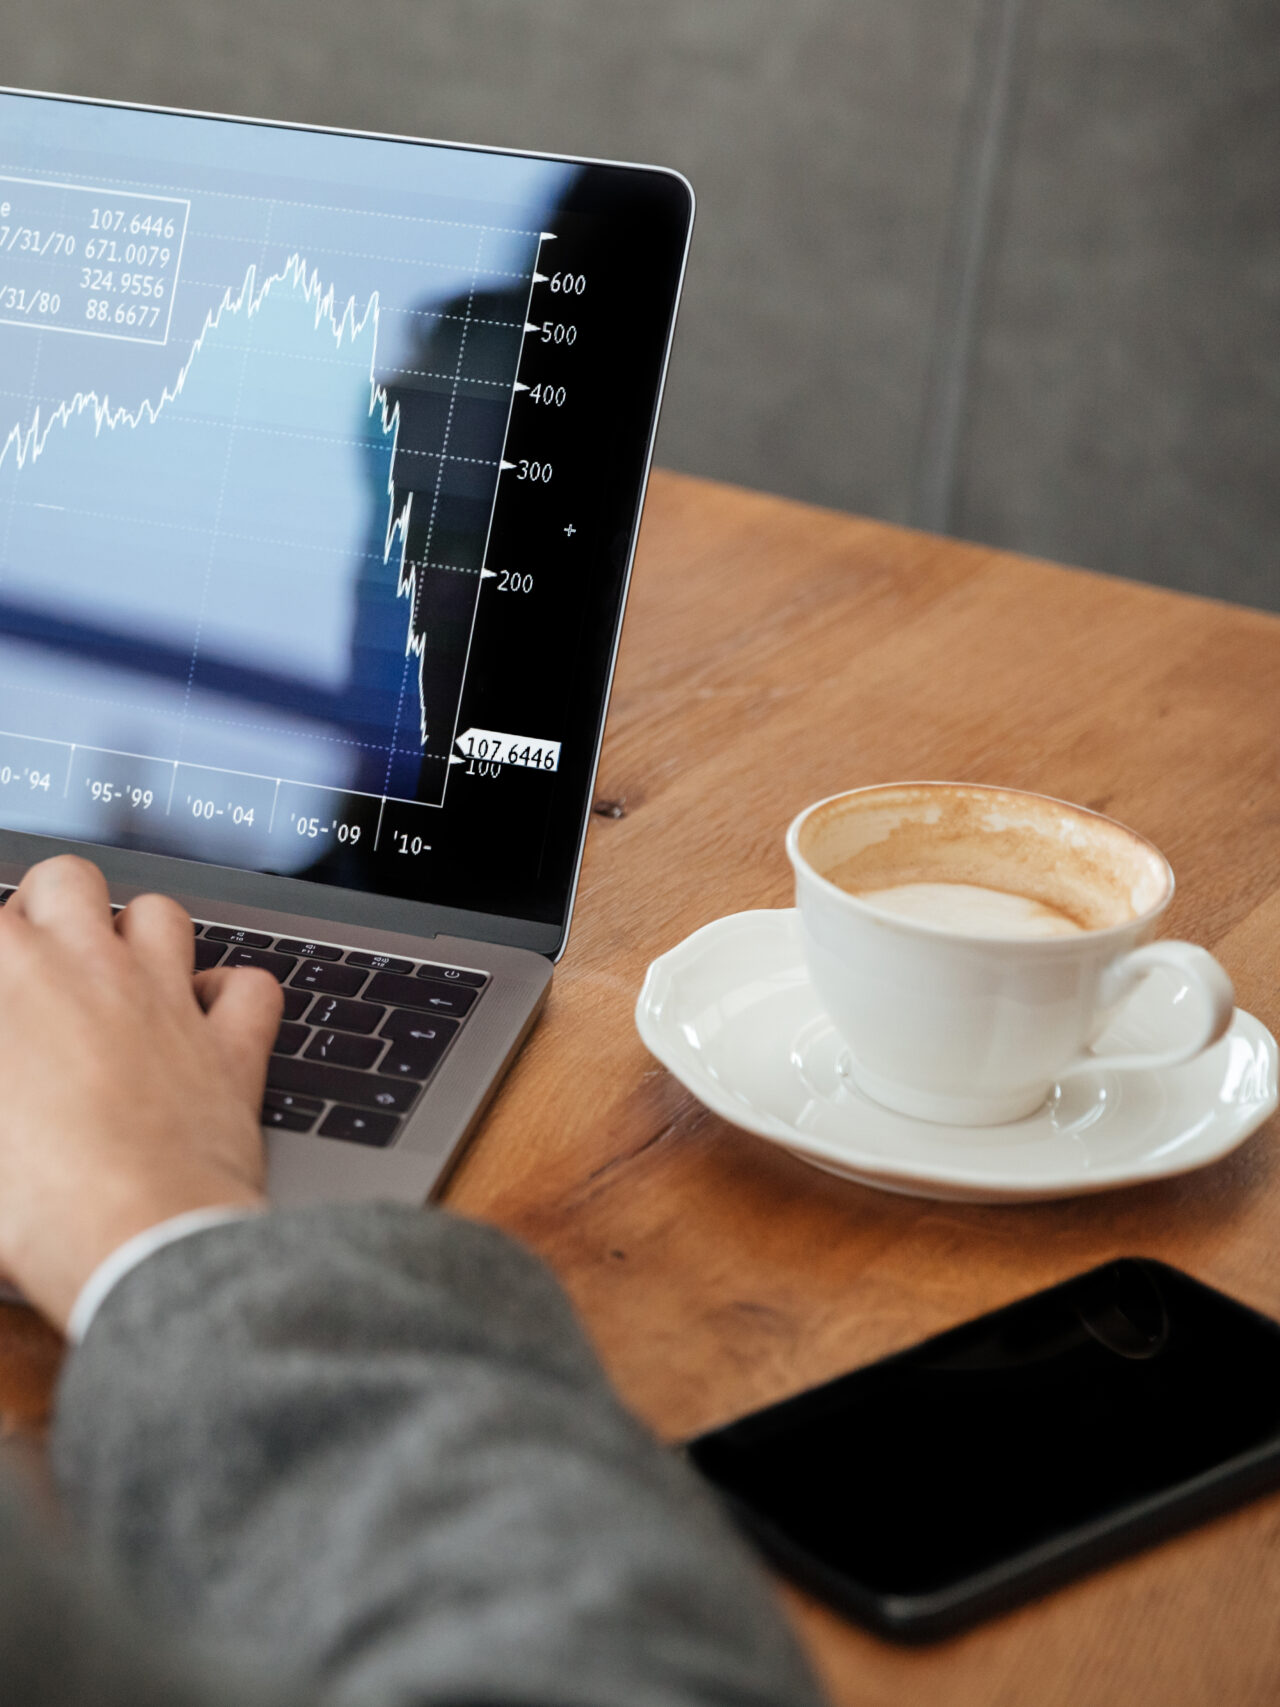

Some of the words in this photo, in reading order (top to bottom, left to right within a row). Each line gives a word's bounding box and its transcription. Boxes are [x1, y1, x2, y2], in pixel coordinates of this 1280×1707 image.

[89, 208, 175, 239] 107.6446
[85, 238, 171, 268] 671.0079
[80, 268, 165, 298] 324.9556
[550, 272, 586, 295] 600
[86, 299, 161, 329] 88.6677
[540, 321, 577, 346] 500
[529, 383, 567, 407] 400
[516, 459, 553, 483] 300
[497, 569, 534, 594] 200
[465, 736, 556, 771] 107.6446
